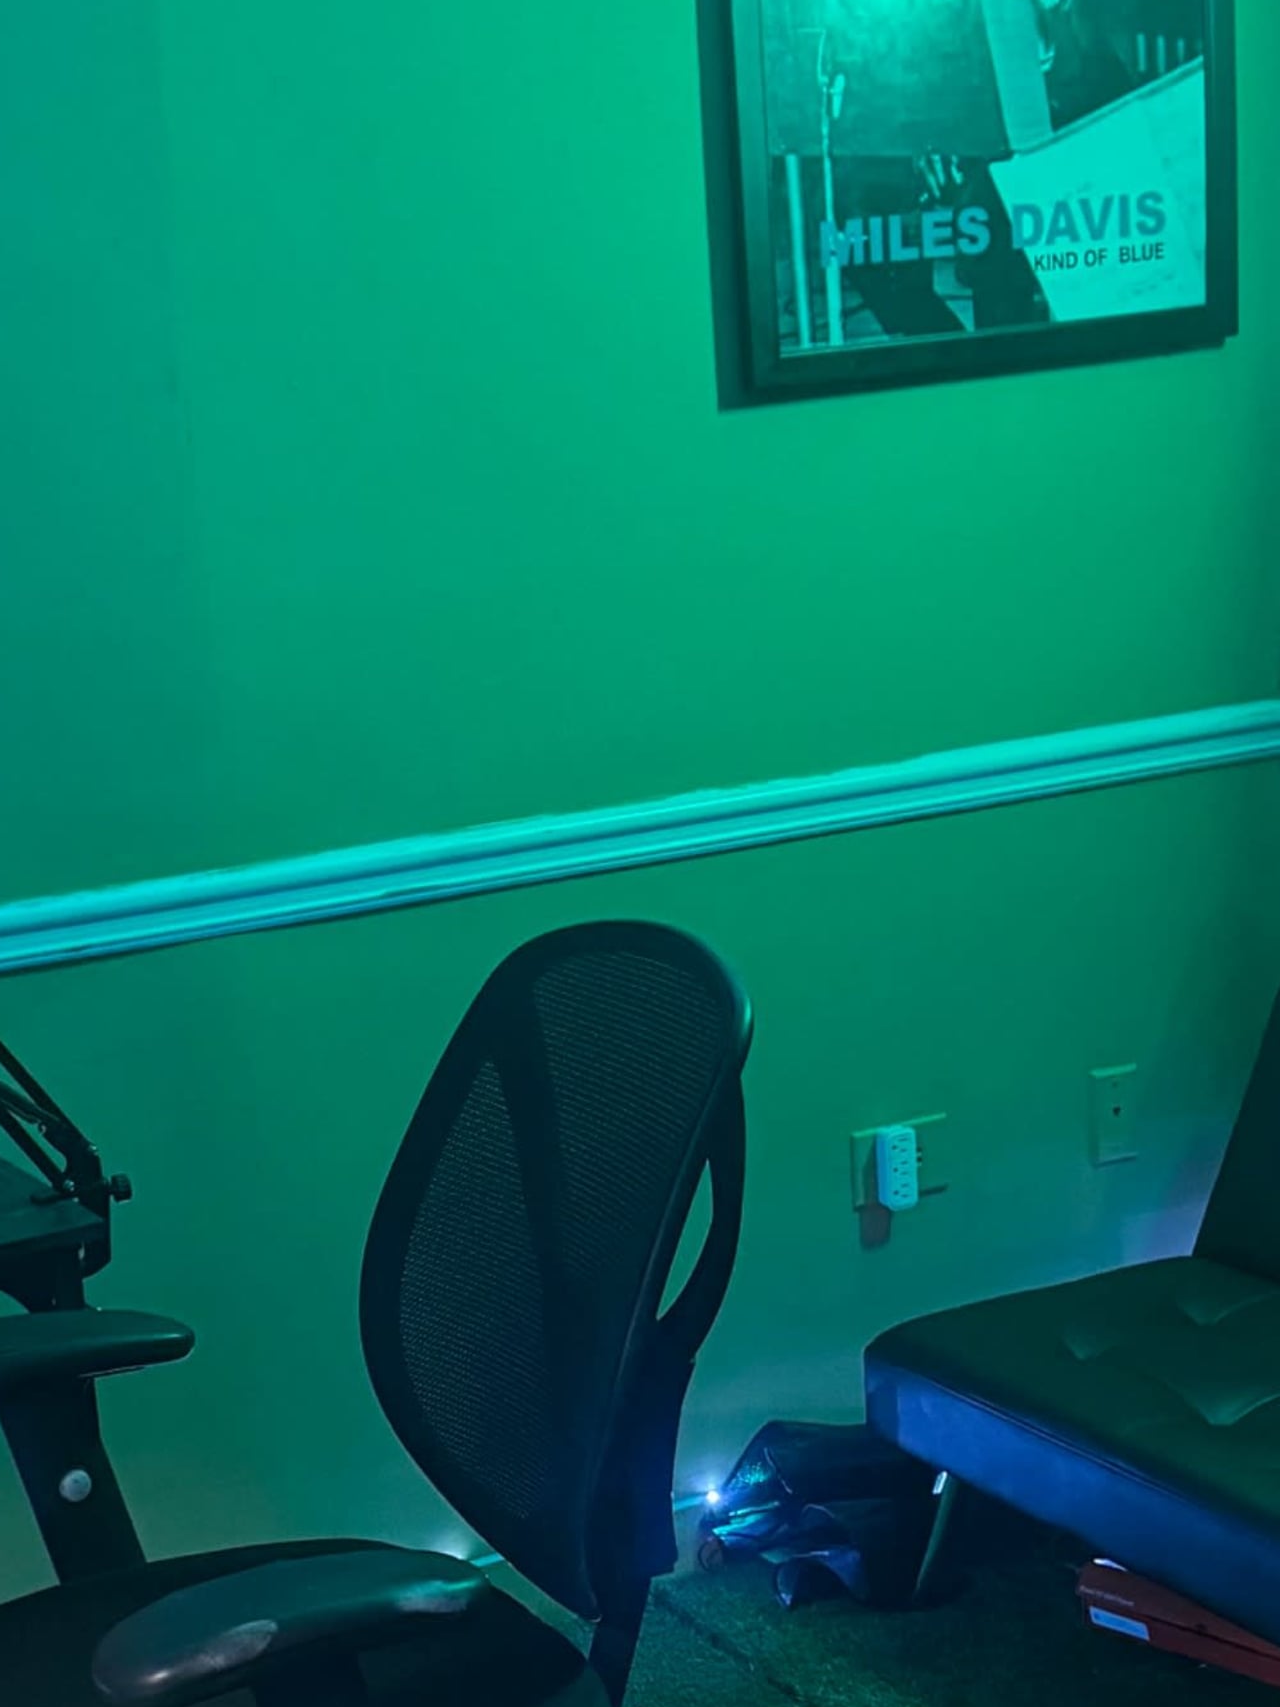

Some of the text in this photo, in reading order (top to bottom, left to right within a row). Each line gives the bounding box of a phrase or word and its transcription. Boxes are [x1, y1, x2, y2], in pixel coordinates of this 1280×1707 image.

[820, 191, 1167, 268] MILES DAVIS
[1034, 243, 1166, 271] KIND OF BLUE
